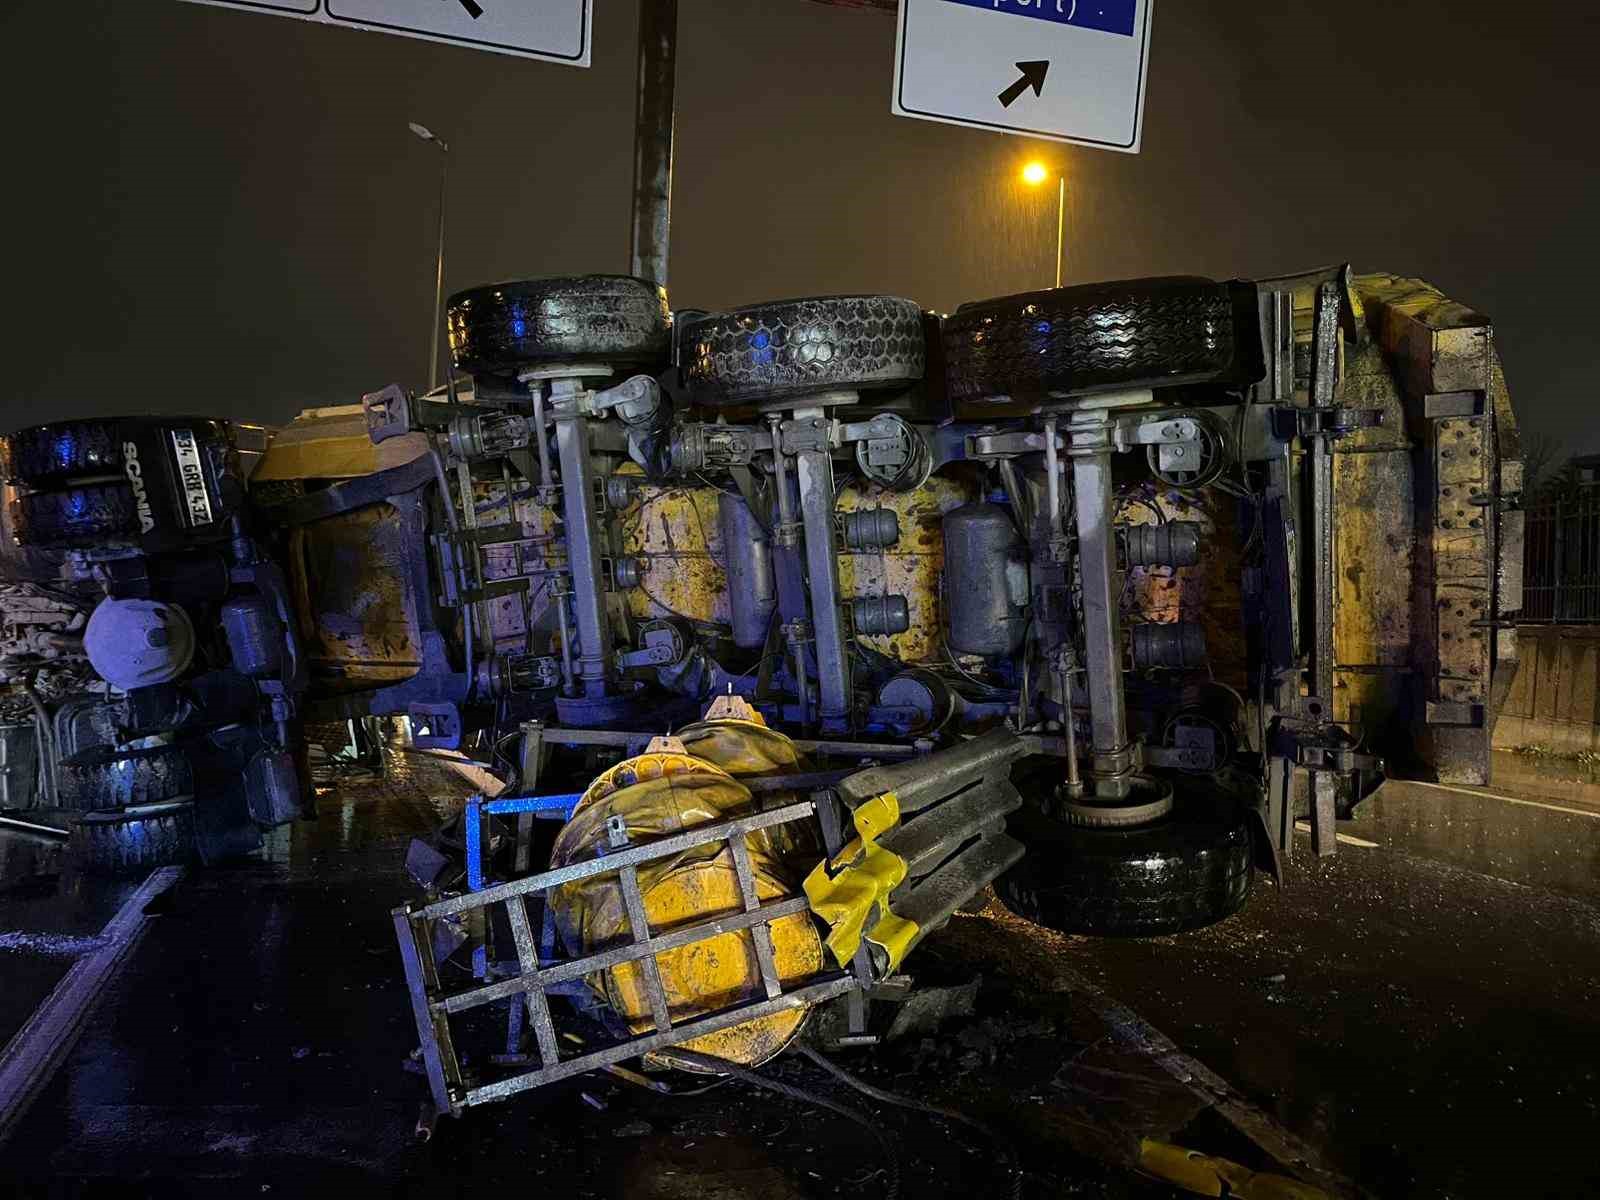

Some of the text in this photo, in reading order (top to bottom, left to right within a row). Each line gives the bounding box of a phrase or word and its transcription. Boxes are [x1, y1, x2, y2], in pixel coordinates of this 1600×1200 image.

[122, 441, 154, 535] SCANIA
[179, 440, 193, 456] 34
[192, 496, 209, 521] 432
